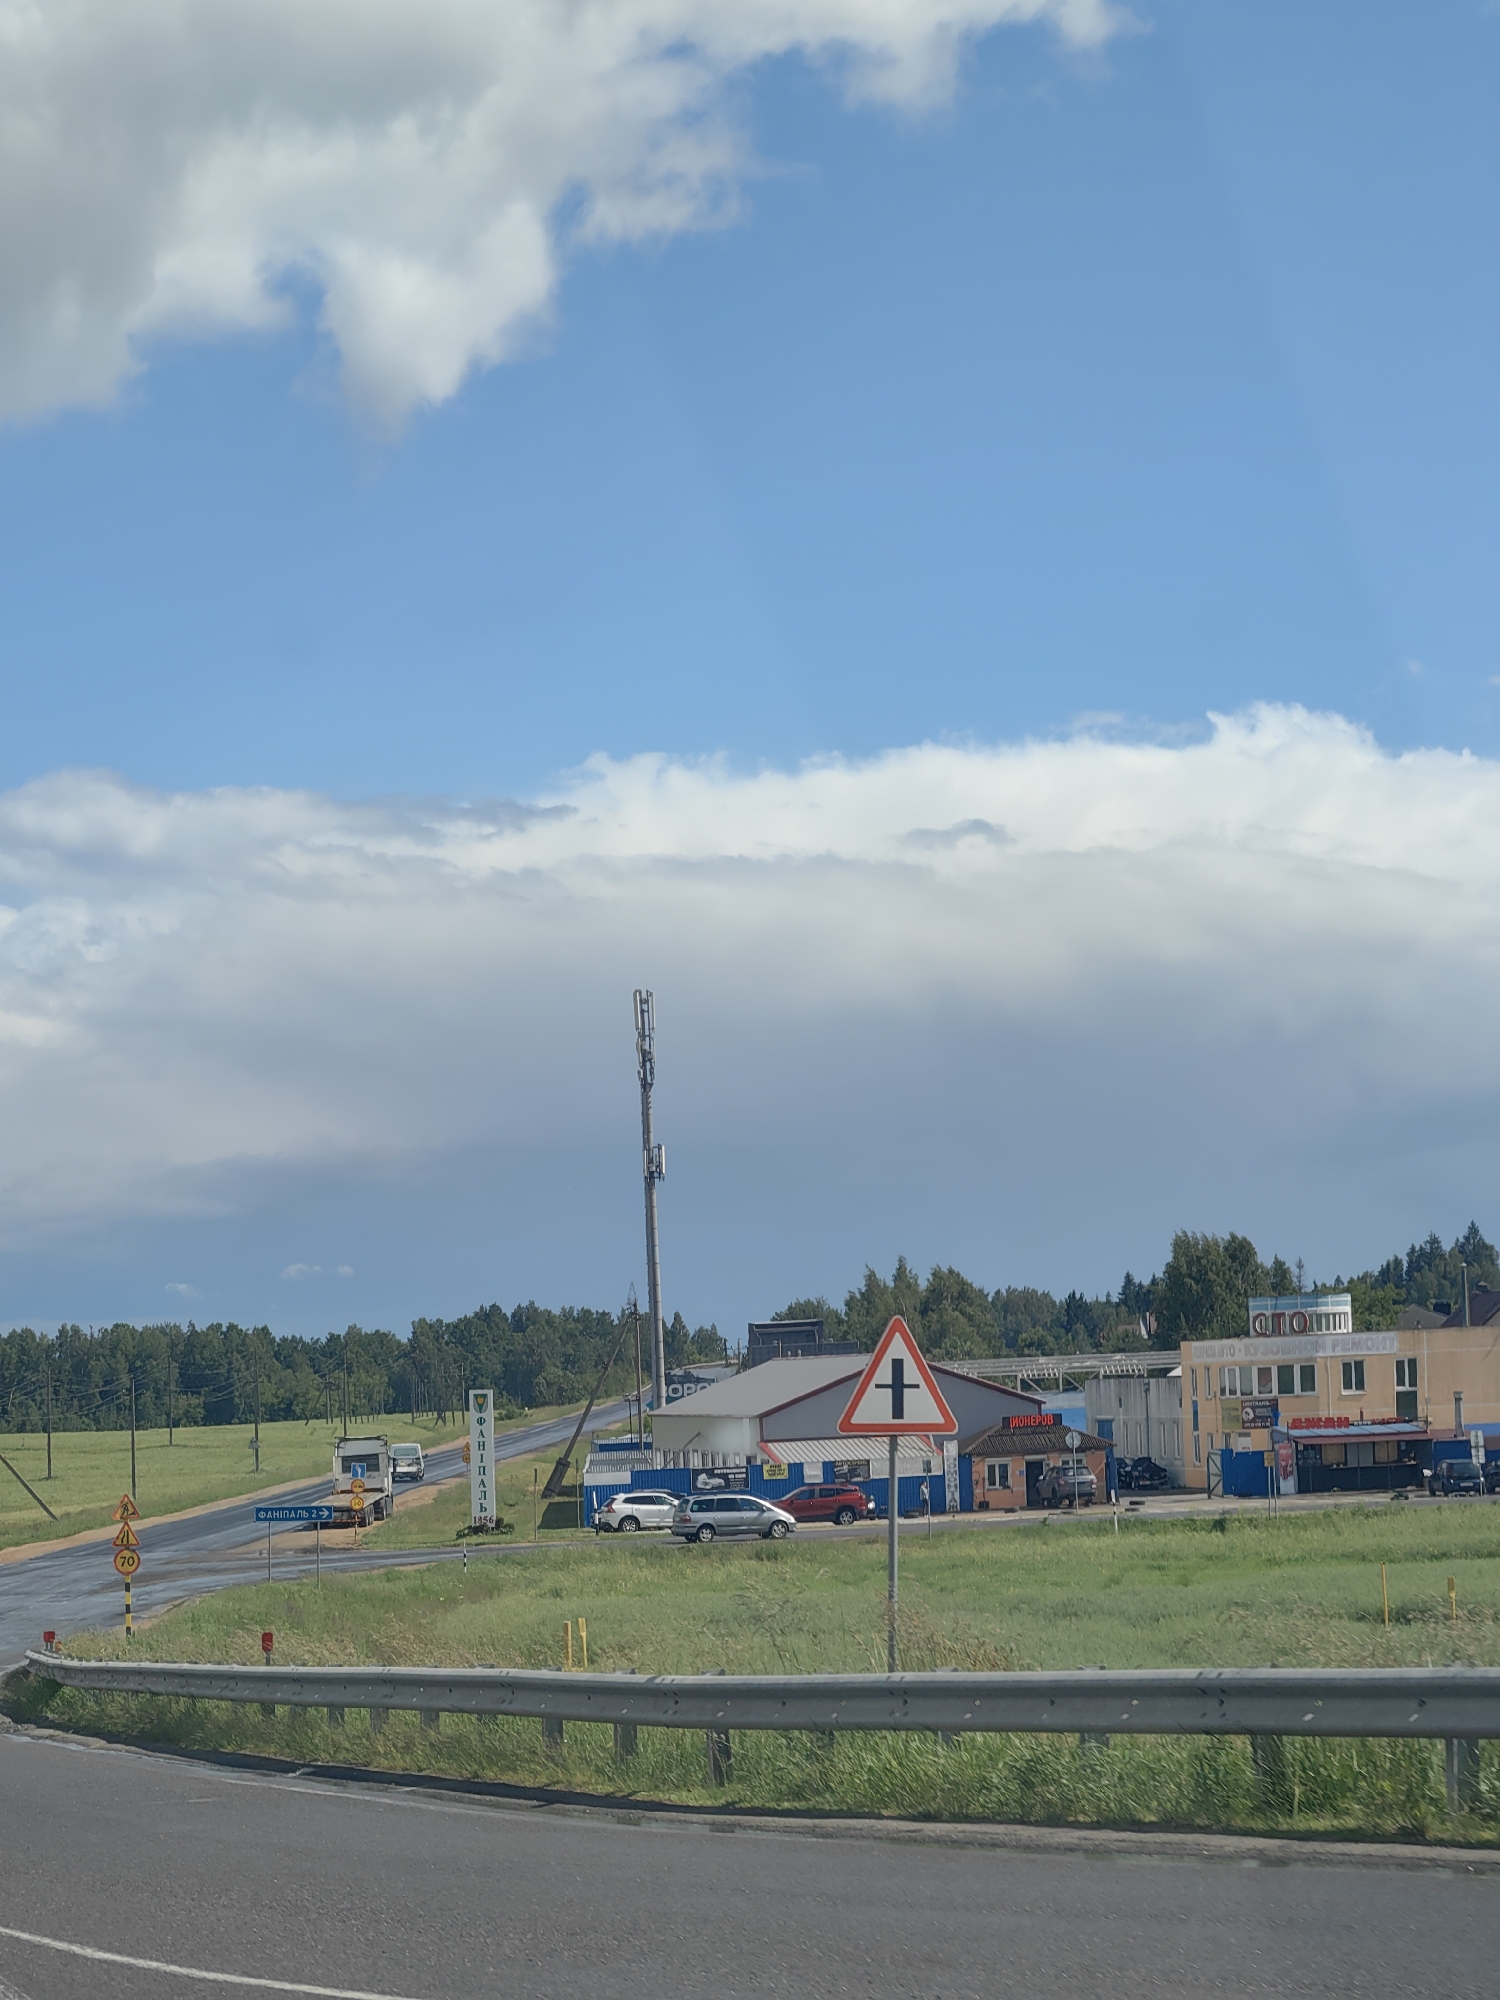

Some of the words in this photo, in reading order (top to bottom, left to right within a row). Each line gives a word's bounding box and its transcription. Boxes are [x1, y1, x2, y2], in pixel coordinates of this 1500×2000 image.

[1252, 1311, 1309, 1336] СТО
[1331, 1335, 1395, 1353] РЕМОНТ
[476, 1416, 488, 1513] ФАНІПАЛЬ
[258, 1509, 309, 1519] ФАНІПАЛЬ
[311, 1509, 317, 1518] 2
[473, 1515, 495, 1525] 1856
[120, 1556, 135, 1567] 70
